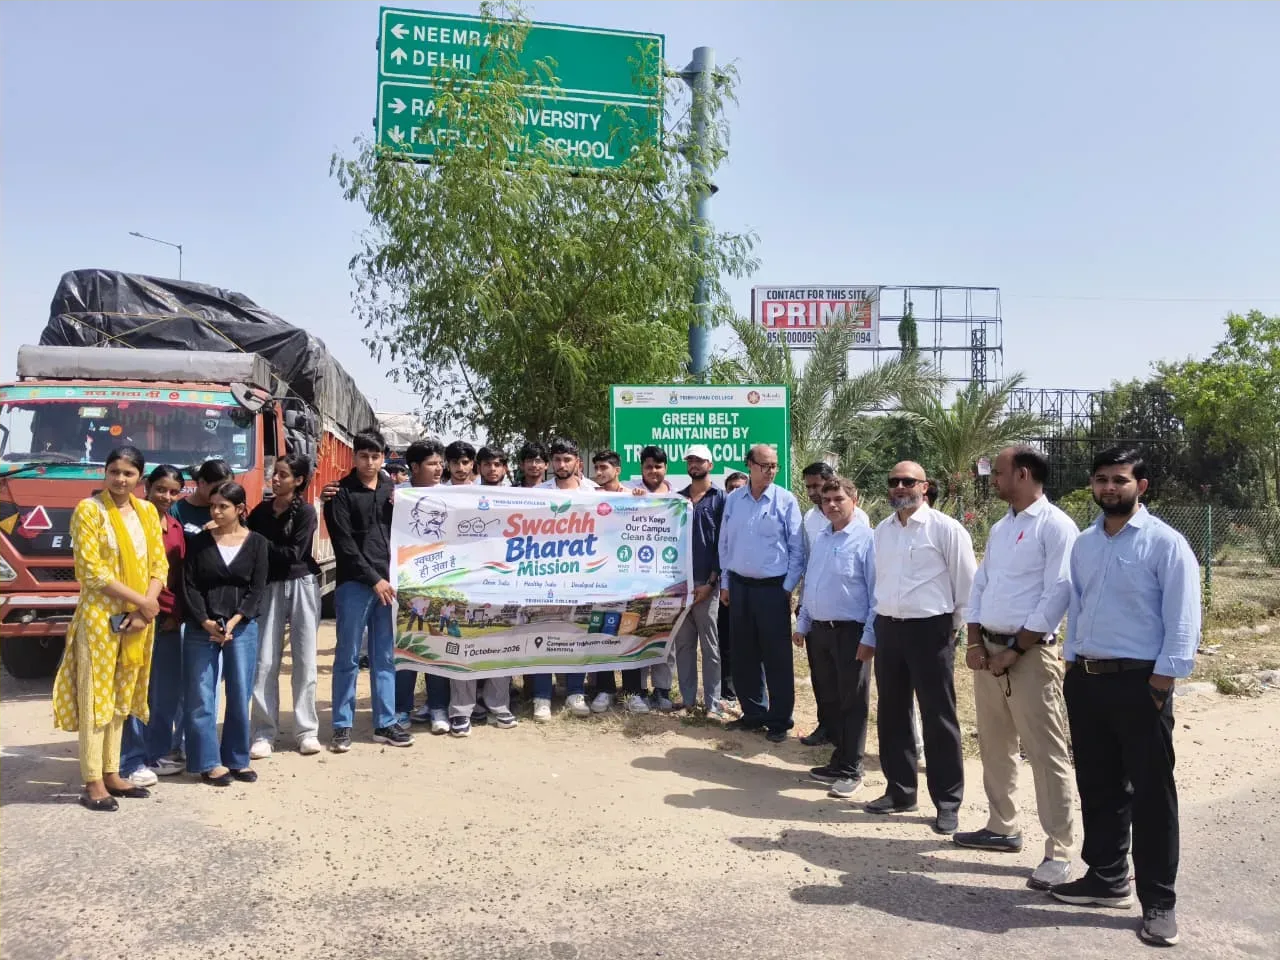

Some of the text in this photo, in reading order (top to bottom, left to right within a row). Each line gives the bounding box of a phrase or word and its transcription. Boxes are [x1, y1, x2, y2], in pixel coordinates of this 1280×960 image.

[412, 49, 471, 70] DELHI
[543, 137, 615, 160] SCHOOL
[767, 289, 867, 300] CONTACT FOR THIS SITE
[662, 412, 739, 426] GREEN BELT
[651, 426, 750, 440] MAINTAINED BY
[502, 512, 595, 537] Swachh
[649, 515, 666, 524] Keep
[625, 523, 671, 533] Our Campus
[620, 532, 678, 543] Clean & Green
[505, 534, 598, 562] Bharat
[432, 560, 448, 573] सेवा
[517, 559, 580, 576] Mission
[469, 647, 501, 657] October
[502, 644, 521, 654] 2026
[546, 640, 568, 648] Campus
